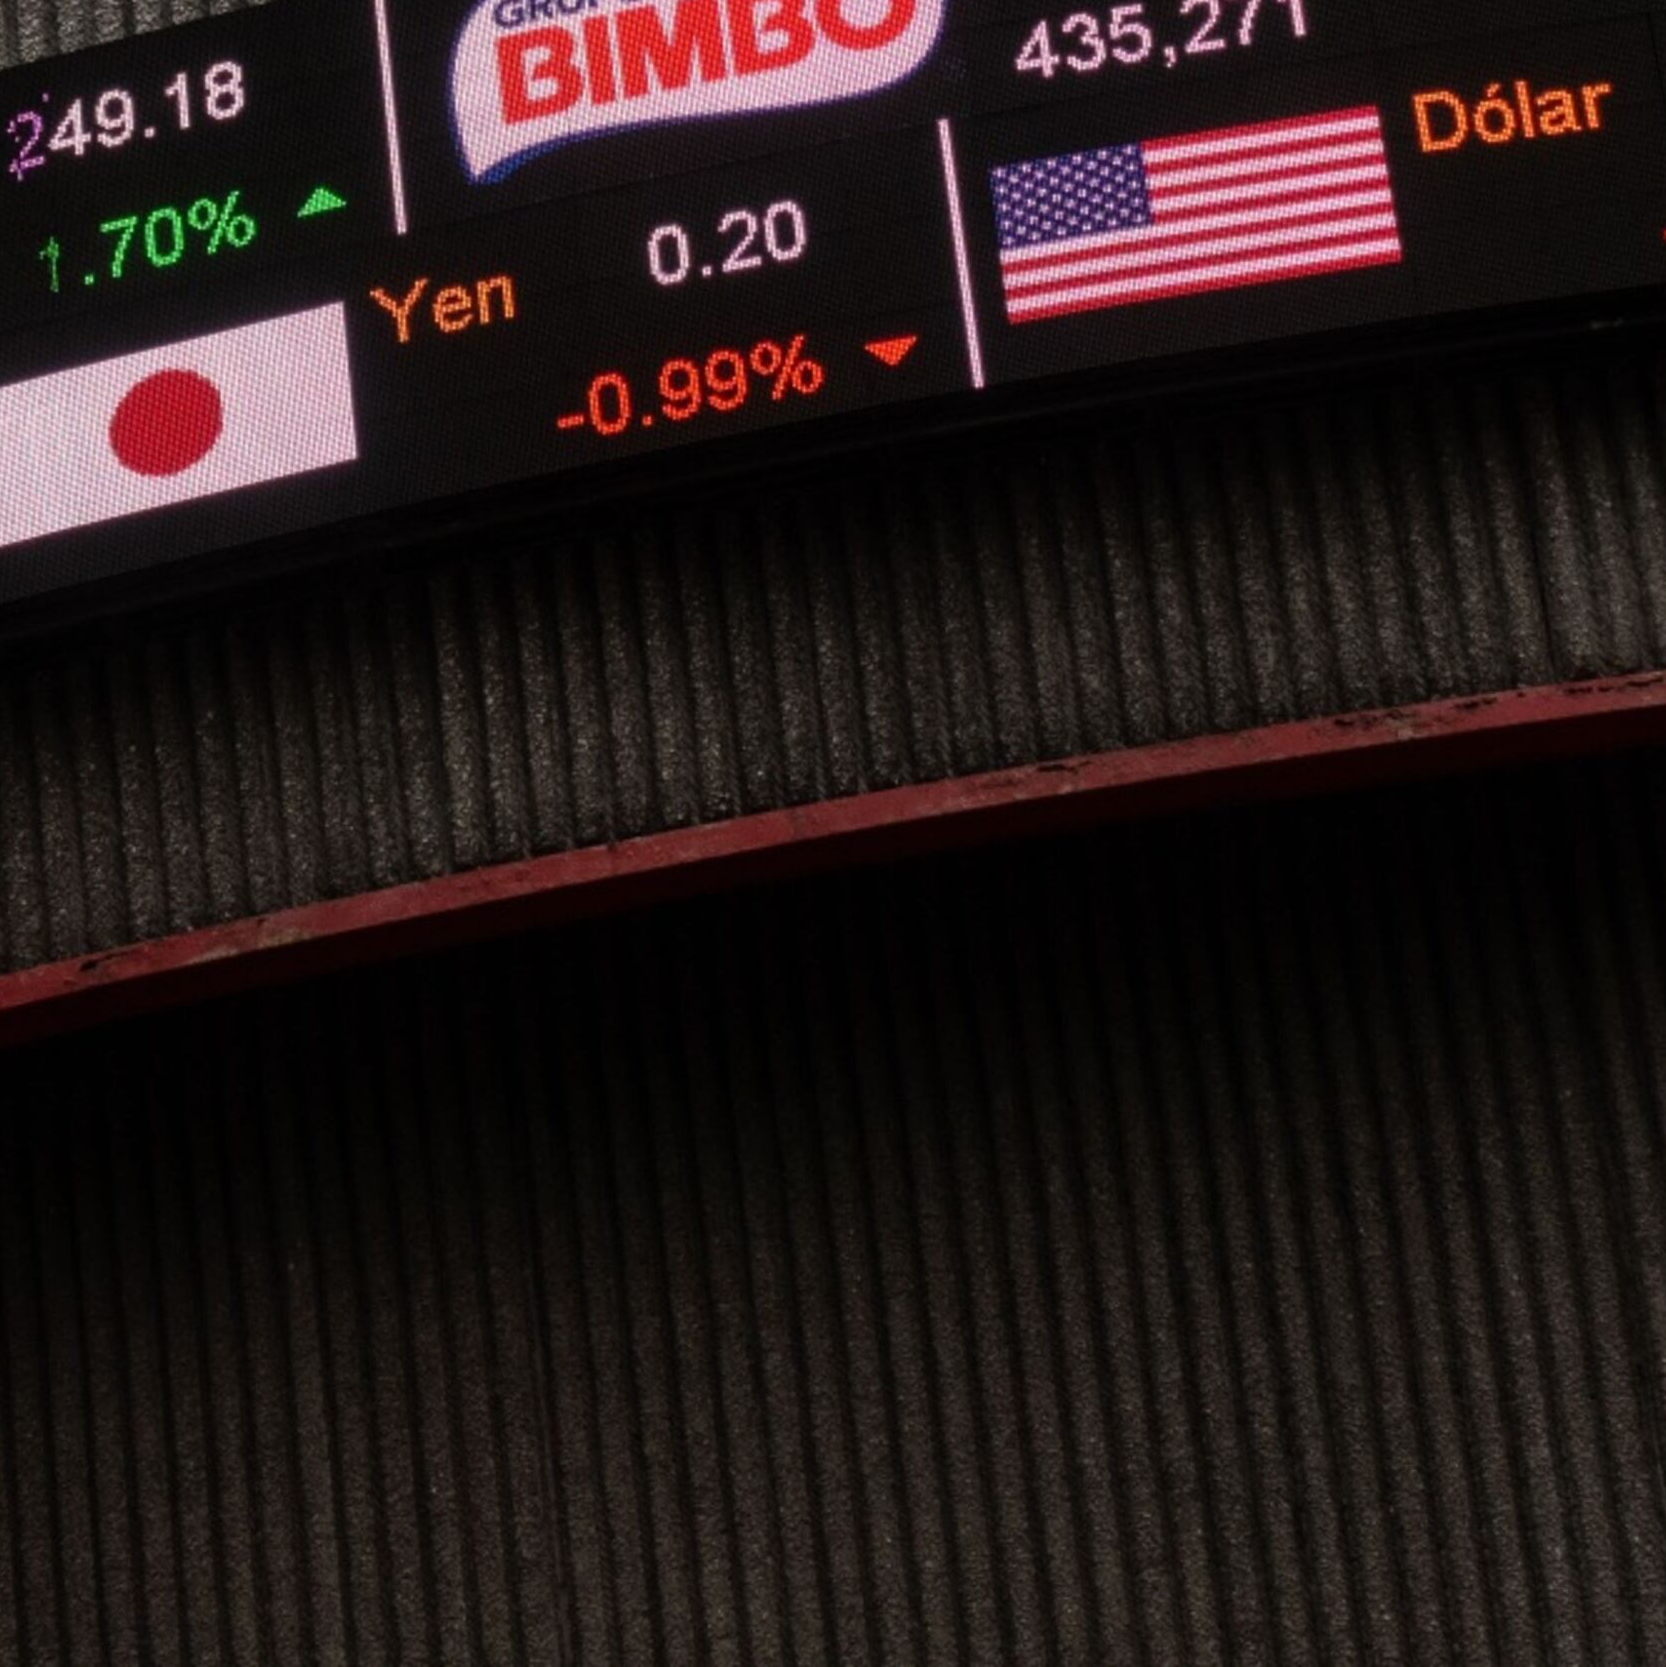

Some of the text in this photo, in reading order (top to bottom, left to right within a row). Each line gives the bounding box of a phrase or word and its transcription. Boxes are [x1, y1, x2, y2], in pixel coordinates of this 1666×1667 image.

[6, 59, 246, 182] 249.18
[1411, 78, 1614, 153] Dólar
[38, 189, 258, 293] 1.70%
[647, 200, 808, 286] 0.20
[369, 274, 517, 344] Yen
[556, 334, 826, 436] -0.99%
